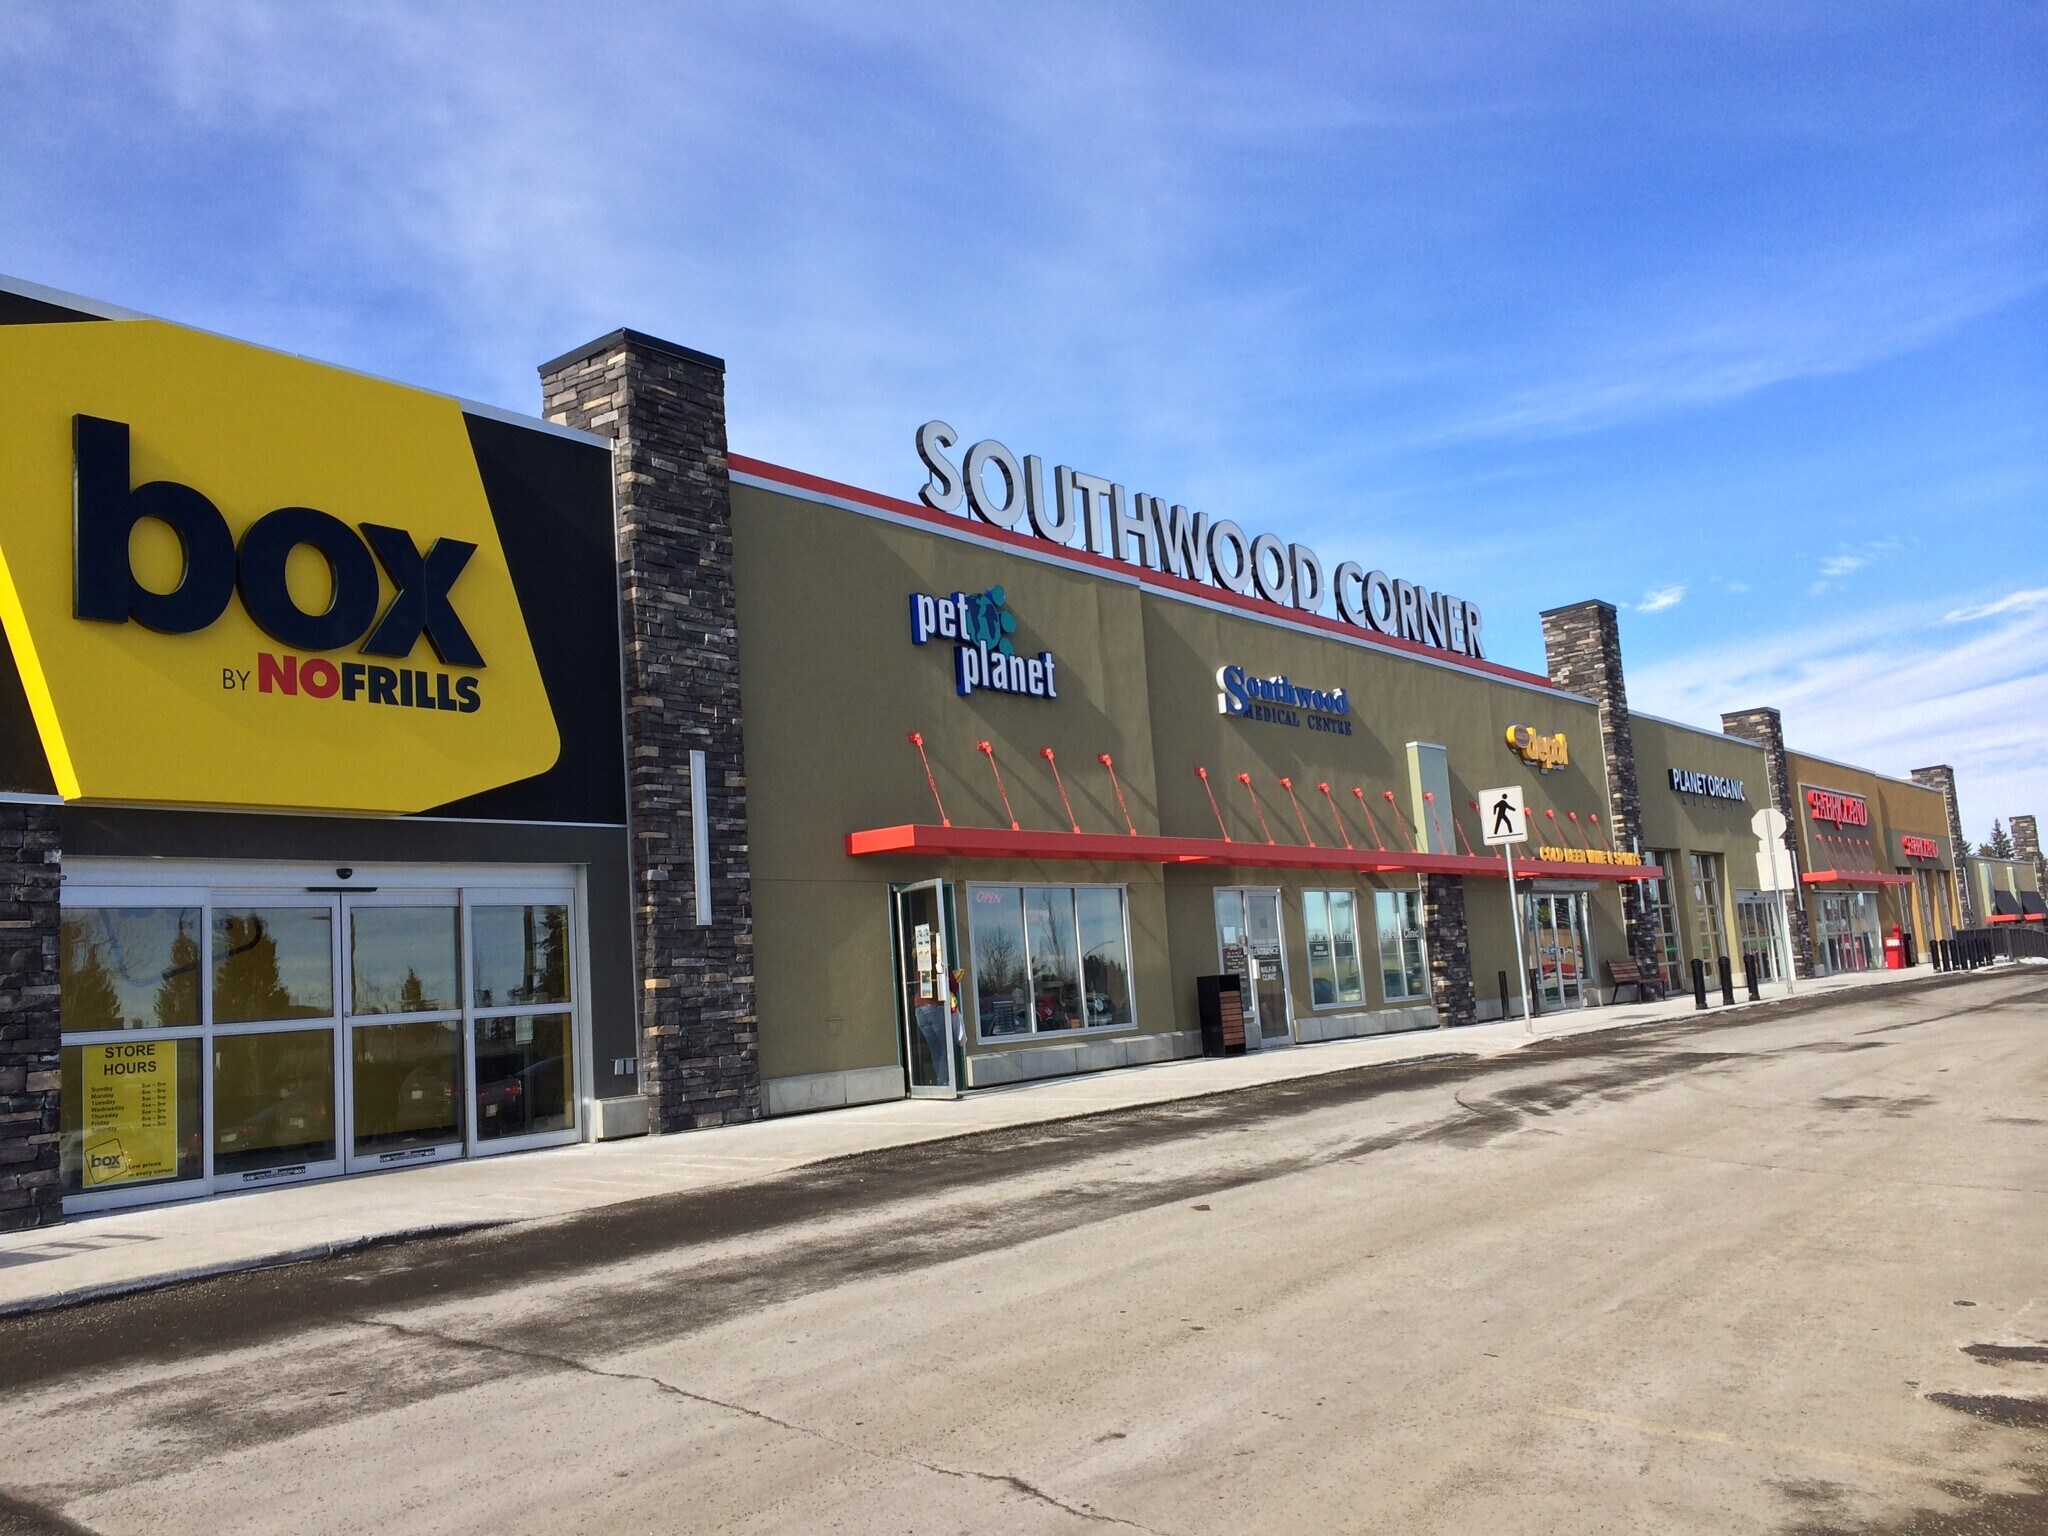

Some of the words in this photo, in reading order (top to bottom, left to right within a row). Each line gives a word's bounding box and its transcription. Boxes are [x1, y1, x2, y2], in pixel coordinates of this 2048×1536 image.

[72, 413, 487, 668] box
[916, 420, 1324, 612] SOUTHWOOD
[1333, 561, 1487, 658] CORNER
[910, 591, 971, 645] pet
[222, 668, 251, 692] BY
[954, 639, 1057, 698] planet
[1216, 664, 1349, 716] Southwood
[1243, 704, 1300, 727] MEDICAL
[1307, 714, 1352, 736] CENTRE
[1669, 767, 1707, 795] PLANET
[1707, 774, 1745, 801] ORGANIC
[1808, 789, 1867, 830] FABRICLAND
[1540, 846, 1564, 861] COLD
[976, 892, 1001, 903] OPEN
[104, 1060, 157, 1076] HOURS
[105, 1044, 156, 1059] STORE
[91, 1155, 120, 1168] box
